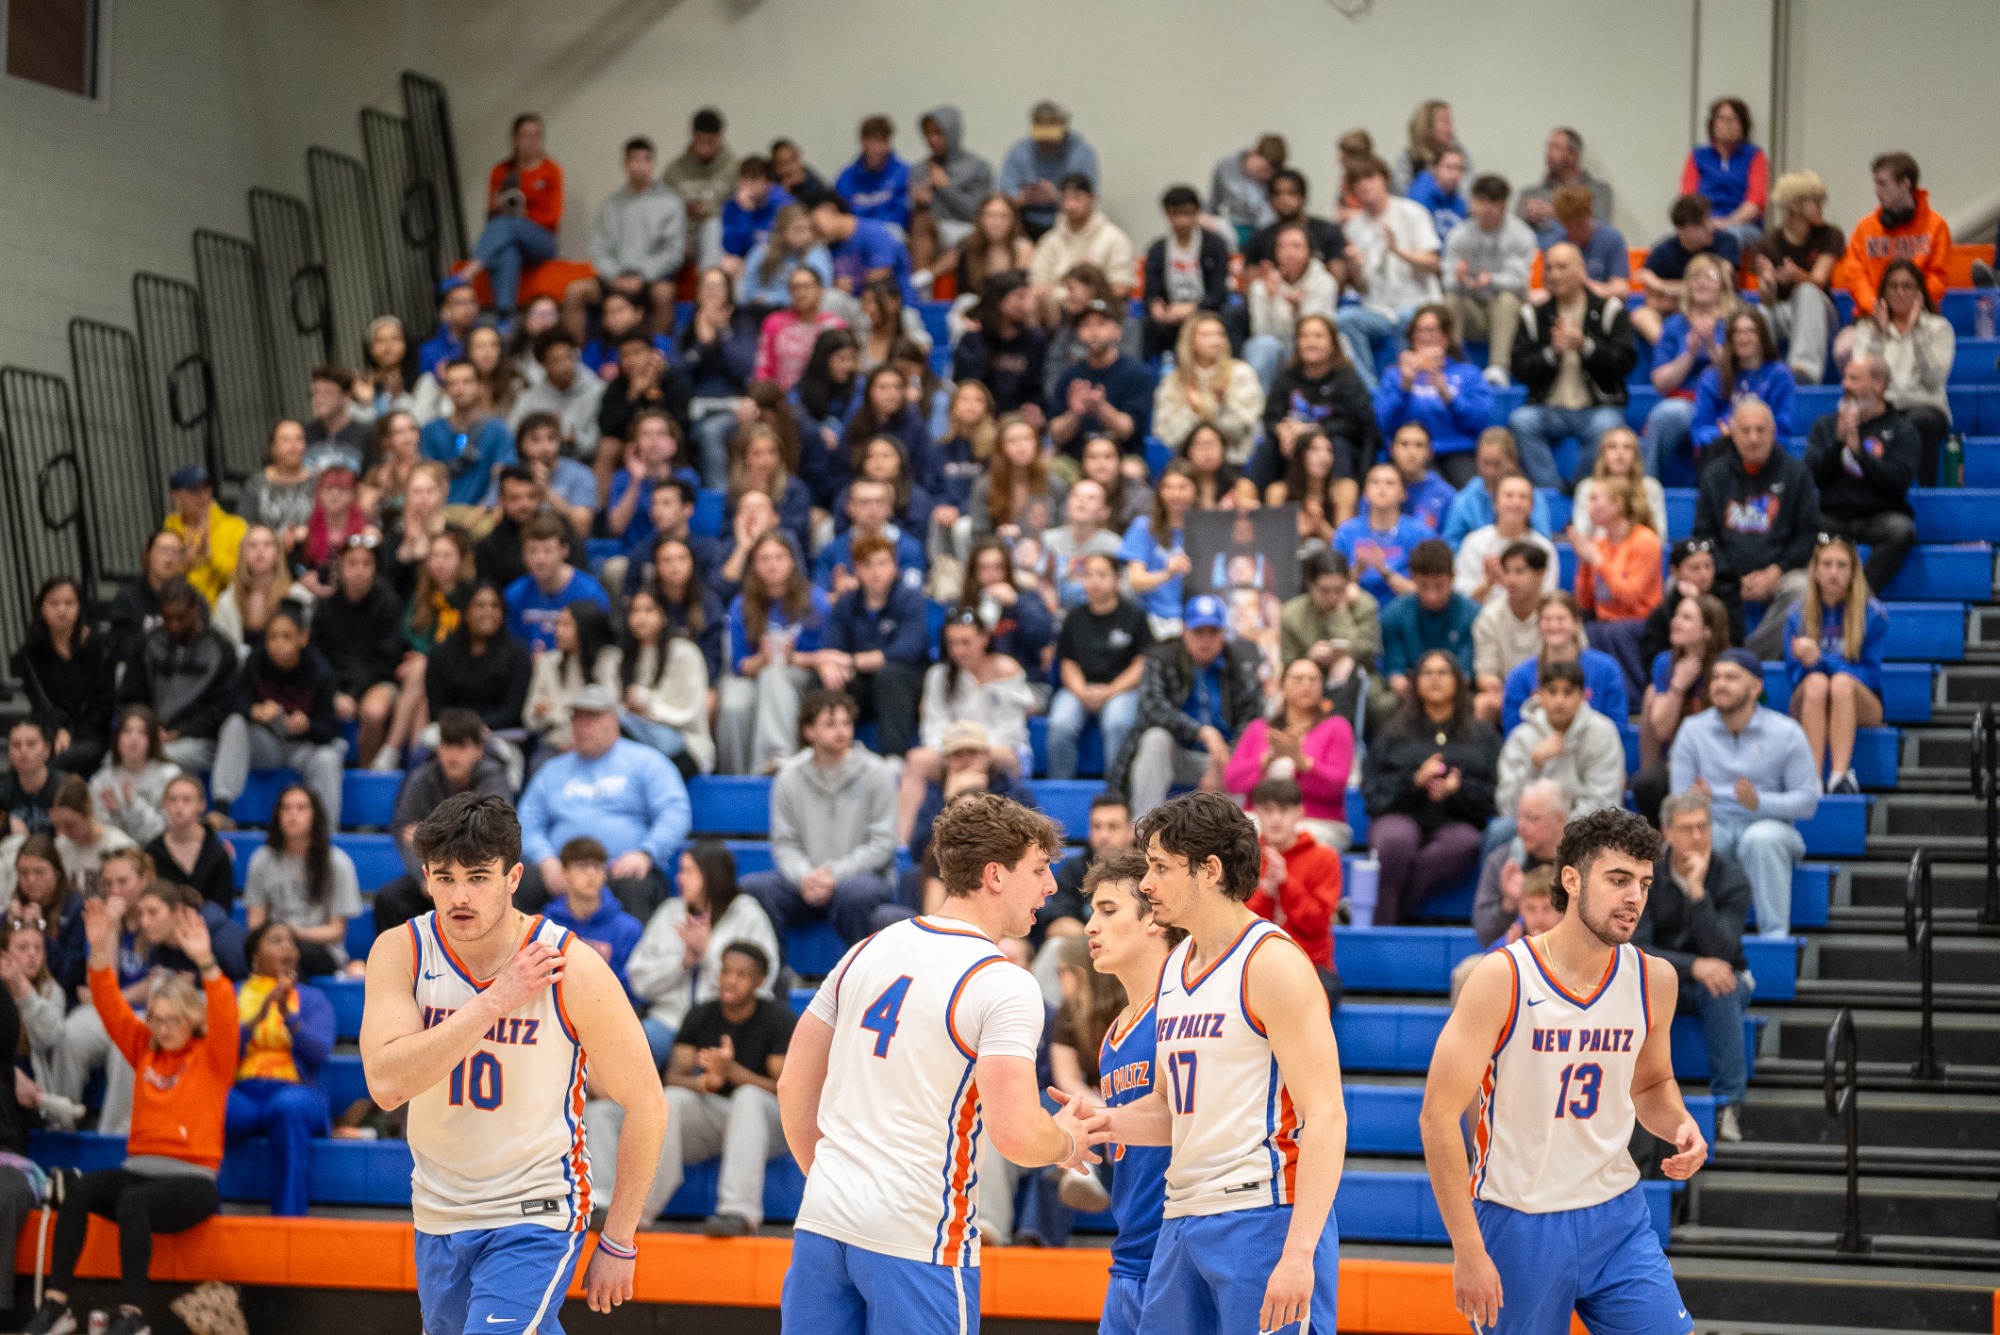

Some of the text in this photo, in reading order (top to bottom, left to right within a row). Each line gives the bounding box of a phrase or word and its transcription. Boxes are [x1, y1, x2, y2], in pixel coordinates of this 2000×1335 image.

[424, 1005, 540, 1045] NE ALTZ
[860, 974, 914, 1059] 4
[1176, 1013, 1226, 1040] PALTZ
[1532, 1027, 1634, 1052] NEW PALTZ
[448, 1050, 504, 1112] 10
[1113, 1061, 1149, 1095] PALTZ
[1168, 1050, 1198, 1115] 17
[1554, 1062, 1604, 1120] 13
